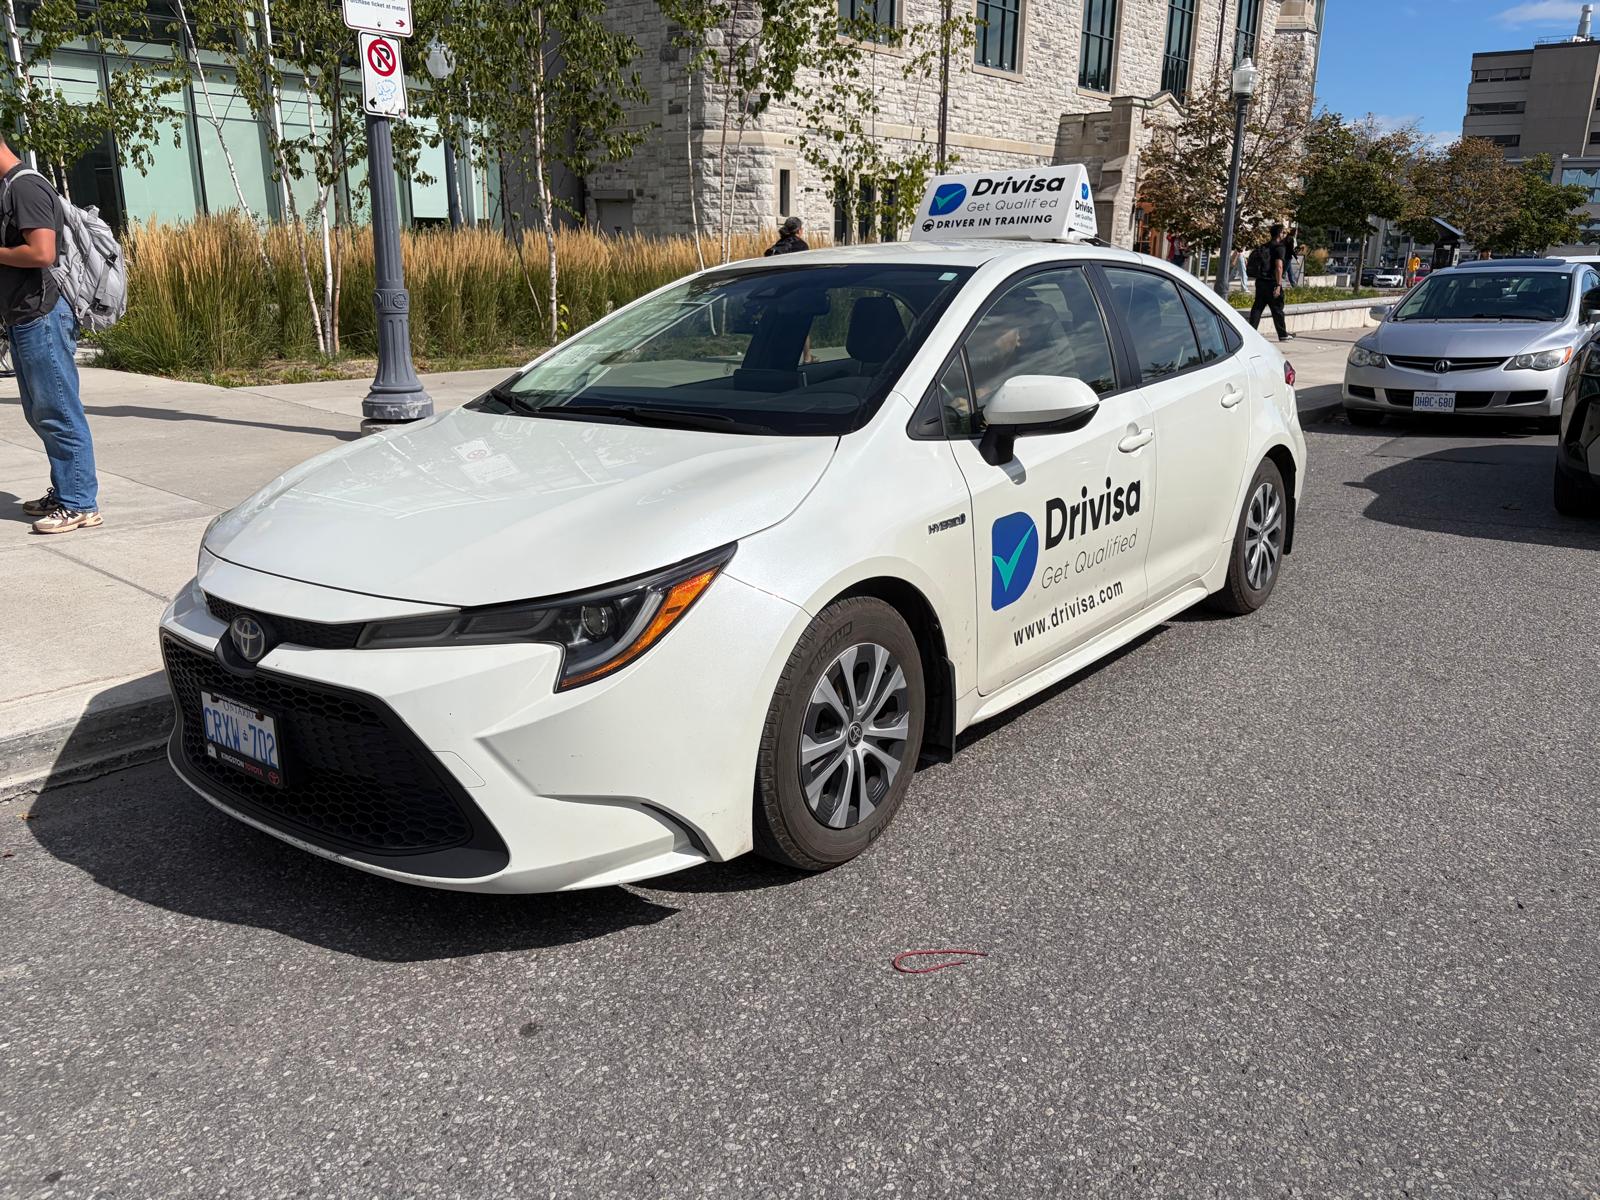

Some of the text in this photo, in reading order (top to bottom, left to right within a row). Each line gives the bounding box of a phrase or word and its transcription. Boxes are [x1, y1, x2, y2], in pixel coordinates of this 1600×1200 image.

[972, 175, 1065, 196] Drivisa
[966, 201, 990, 212] Get
[1075, 200, 1092, 214] Drivisa
[936, 214, 1053, 229] DRIVER IN TRAINING
[1045, 476, 1141, 550] Drivisa
[928, 515, 962, 535] HYBRID
[1041, 528, 1138, 589] Get Qualified
[1013, 580, 1124, 647] www.drivisa.com
[204, 707, 277, 769] CRXW 702
